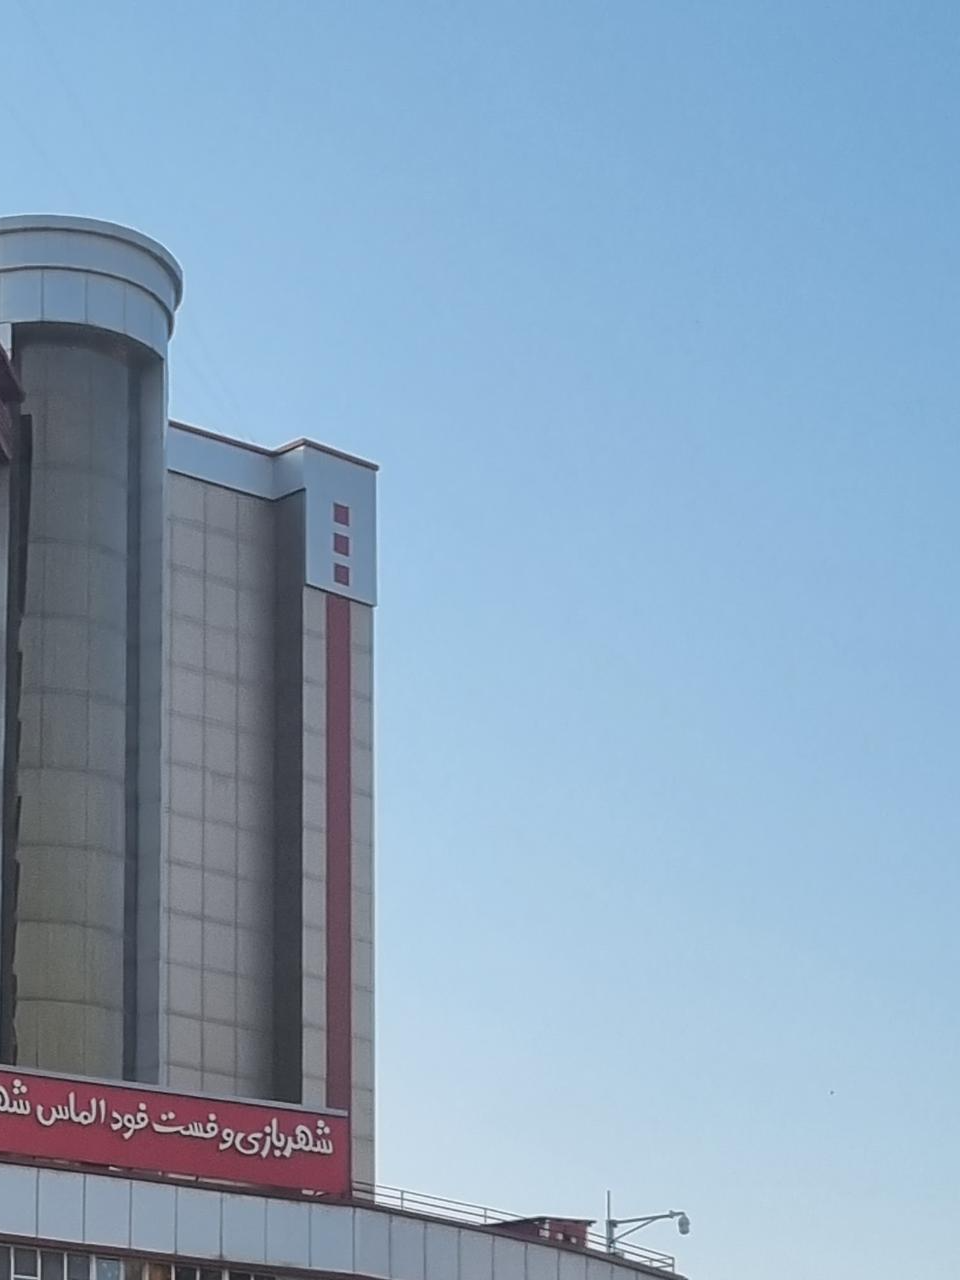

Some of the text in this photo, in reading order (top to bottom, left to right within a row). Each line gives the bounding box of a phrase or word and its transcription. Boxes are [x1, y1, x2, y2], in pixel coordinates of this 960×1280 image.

[36, 1091, 107, 1127] الماس
[110, 1102, 149, 1140] فود
[152, 1111, 219, 1139] فست
[234, 1117, 334, 1158] شهربازی
